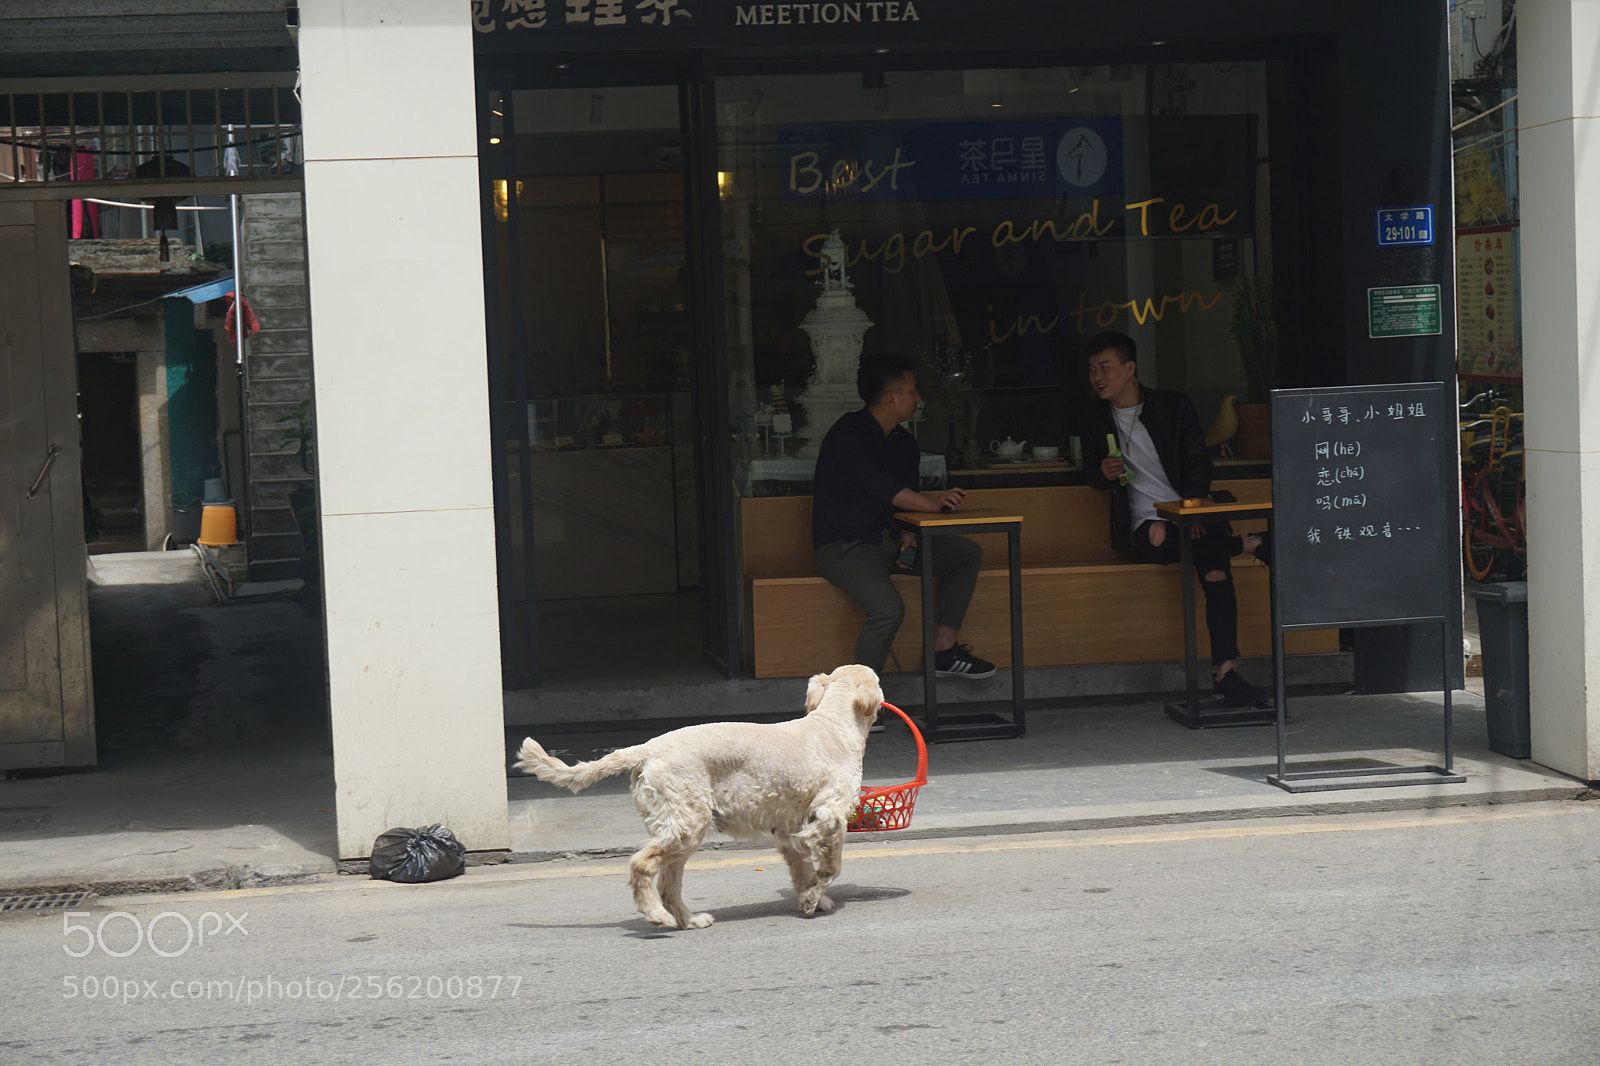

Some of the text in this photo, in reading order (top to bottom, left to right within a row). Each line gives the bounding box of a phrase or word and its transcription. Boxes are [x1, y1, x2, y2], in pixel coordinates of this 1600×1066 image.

[787, 147, 916, 194] Best
[802, 197, 1239, 276] Sugar and Tea
[1384, 210, 1425, 222] 大学路
[1385, 225, 1416, 241] 29-101
[985, 289, 1223, 345] in town
